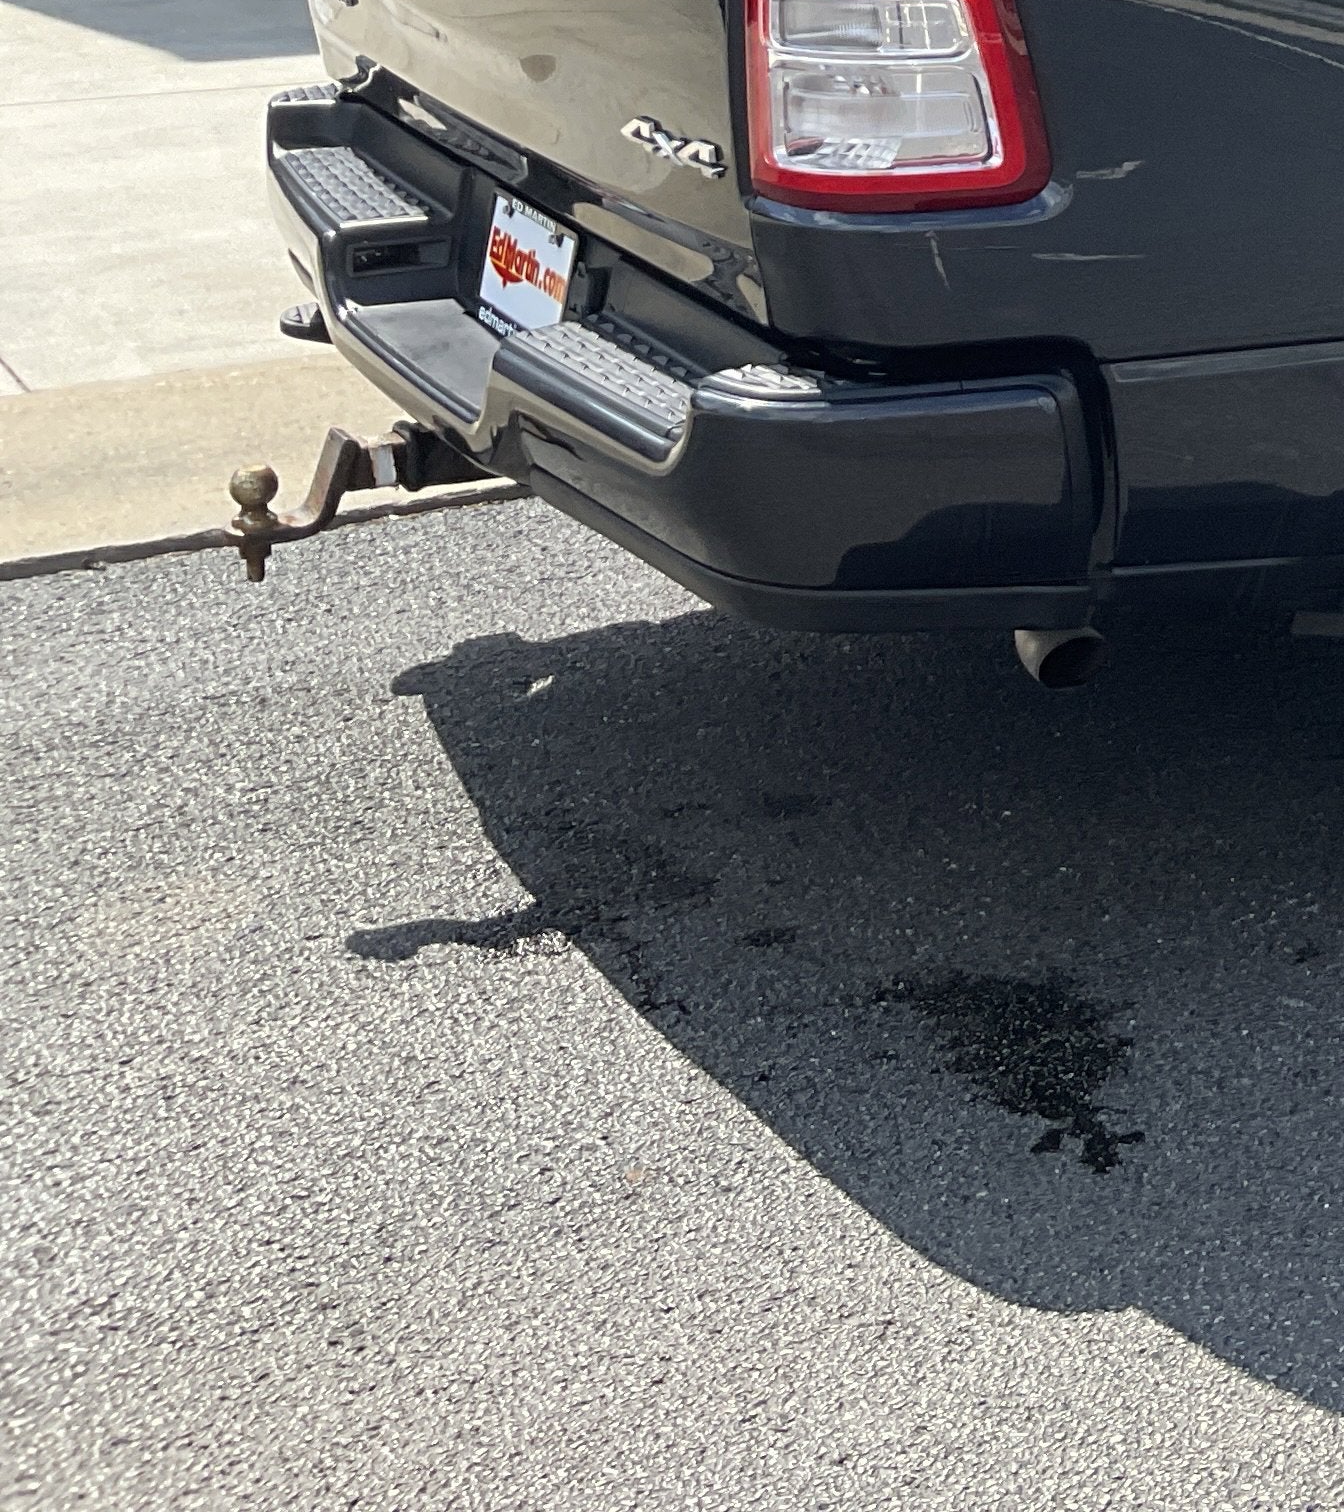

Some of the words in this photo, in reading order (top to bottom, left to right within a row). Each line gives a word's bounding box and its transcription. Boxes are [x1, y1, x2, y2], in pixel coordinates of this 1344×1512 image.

[512, 198, 524, 212] ED
[524, 205, 557, 234] MARTIN
[489, 226, 568, 304] EdMartin.com
